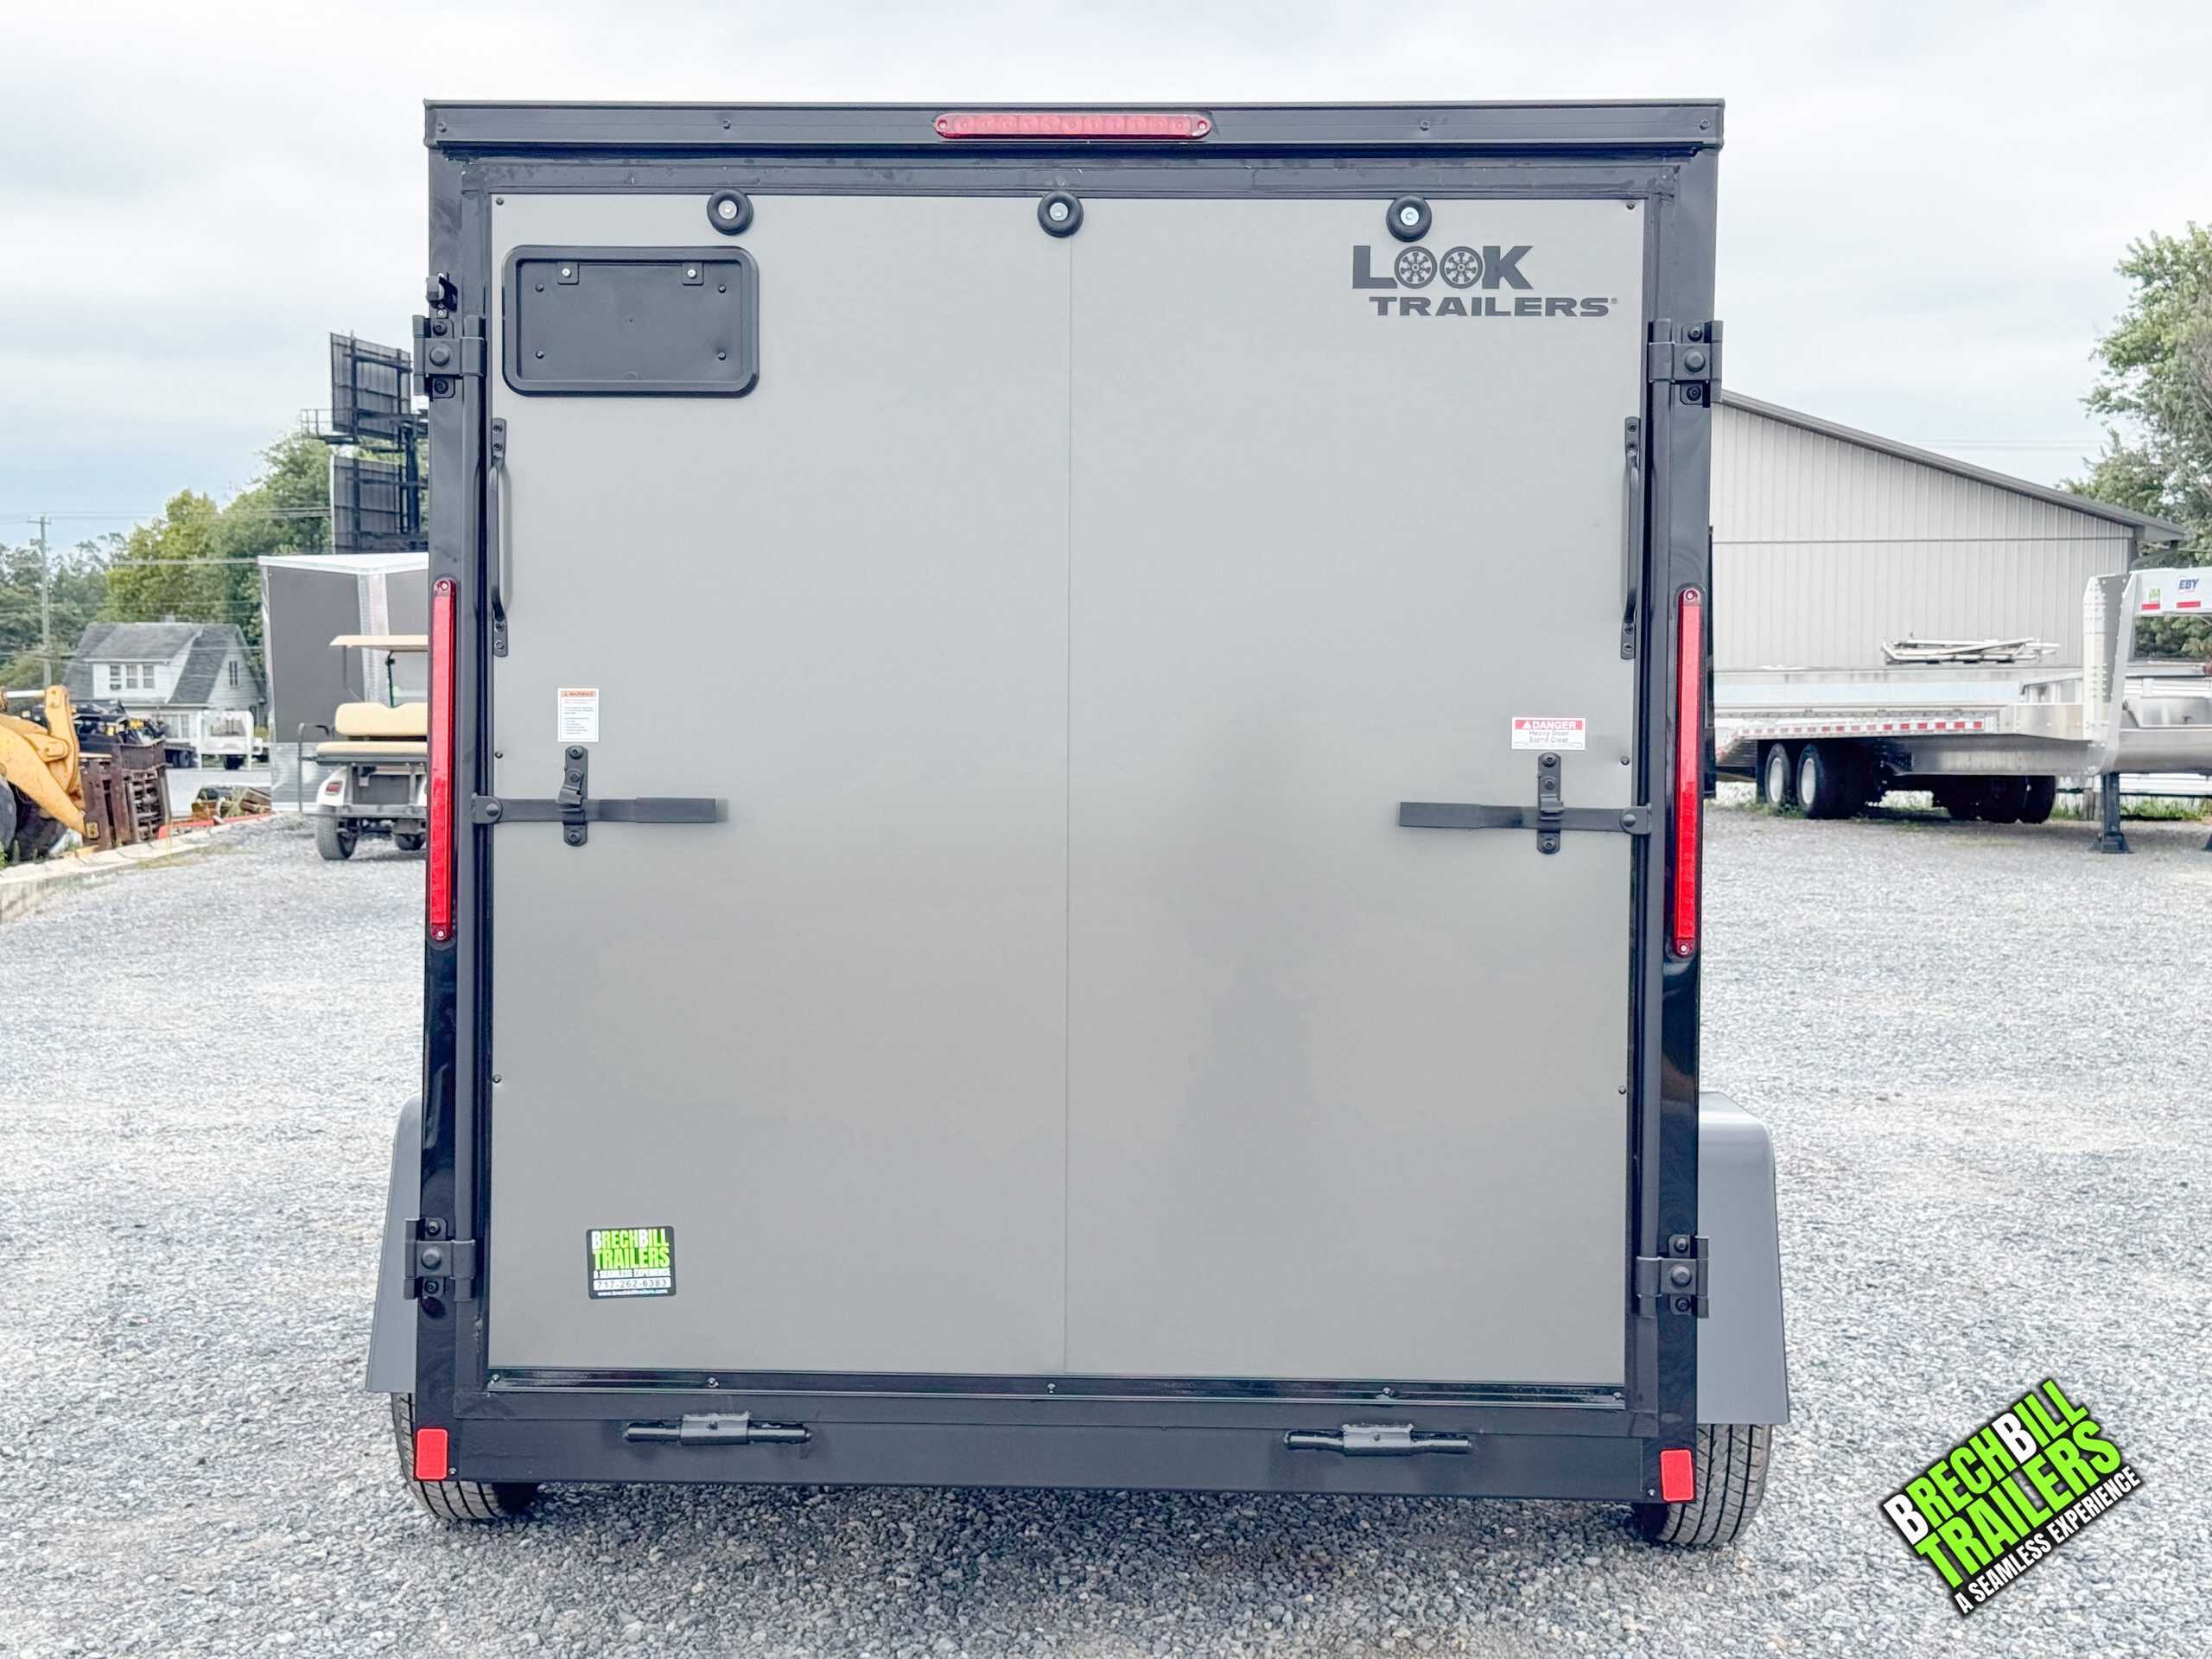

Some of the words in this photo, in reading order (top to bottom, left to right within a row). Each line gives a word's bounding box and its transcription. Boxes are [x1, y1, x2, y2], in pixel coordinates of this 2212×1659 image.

[1352, 245, 1534, 289] LOOK
[1369, 296, 1609, 317] TRAILERS
[2178, 579, 2199, 589] EBY
[1532, 721, 1577, 729] DANGER
[591, 1229, 670, 1249] BRECHBILL
[593, 1247, 671, 1270] TRAILERS
